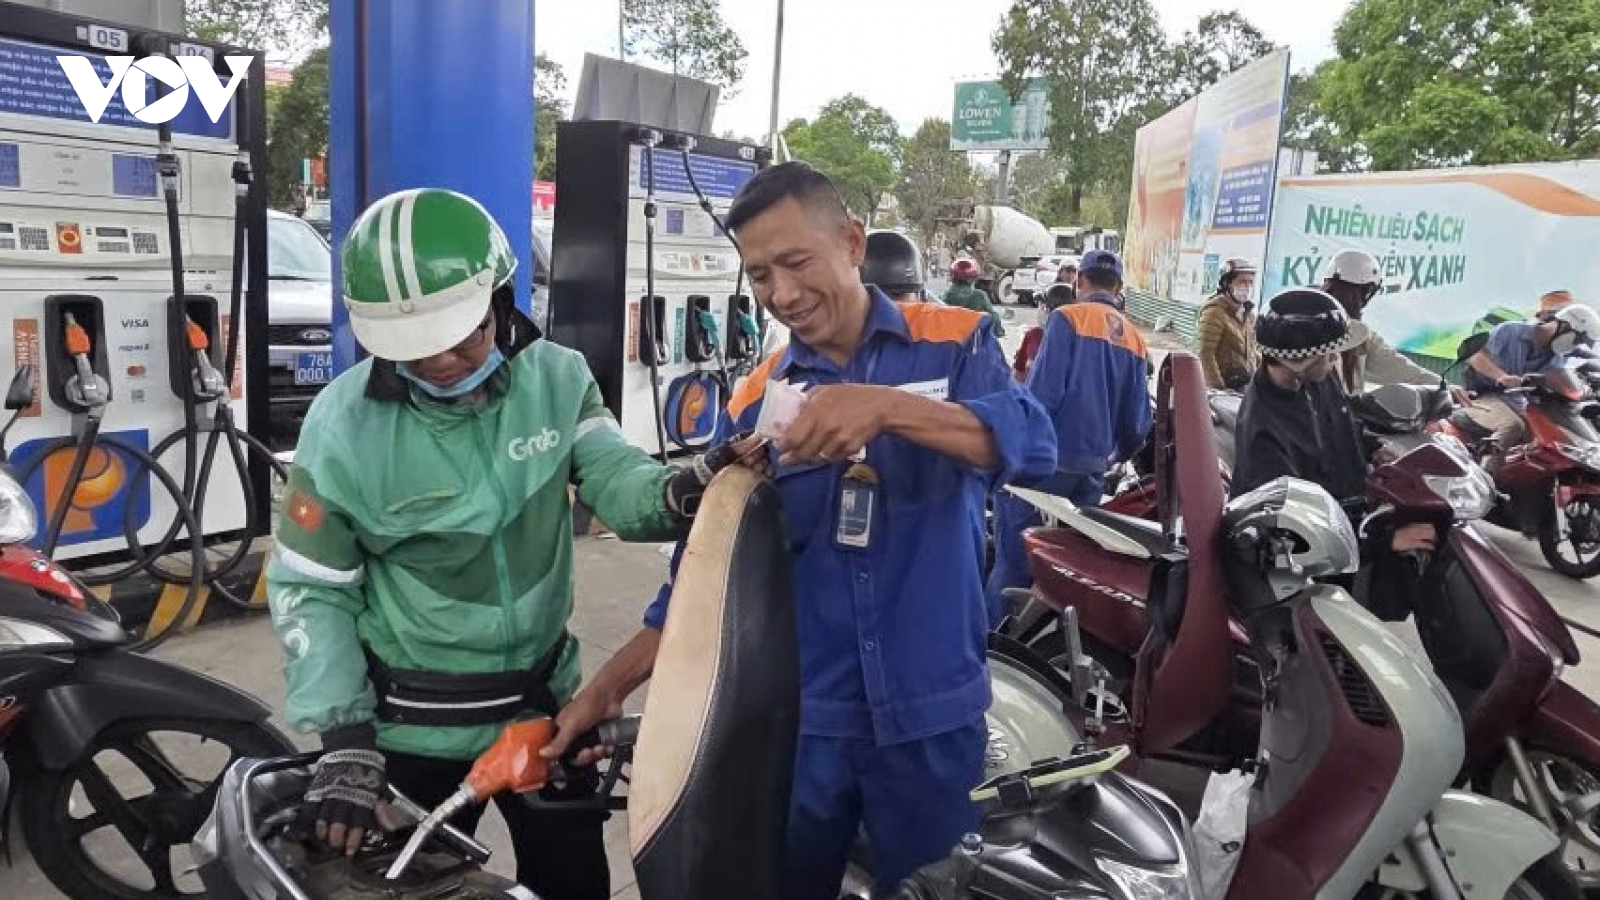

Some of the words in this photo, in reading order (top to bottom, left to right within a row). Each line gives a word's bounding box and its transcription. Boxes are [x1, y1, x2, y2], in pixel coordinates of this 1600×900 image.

[97, 29, 122, 48] 05
[1304, 203, 1375, 238] NHIÊN
[1412, 210, 1466, 251] SẠCH
[1405, 255, 1467, 291] XANH
[121, 318, 149, 329] VISA
[508, 427, 561, 461] Grab
